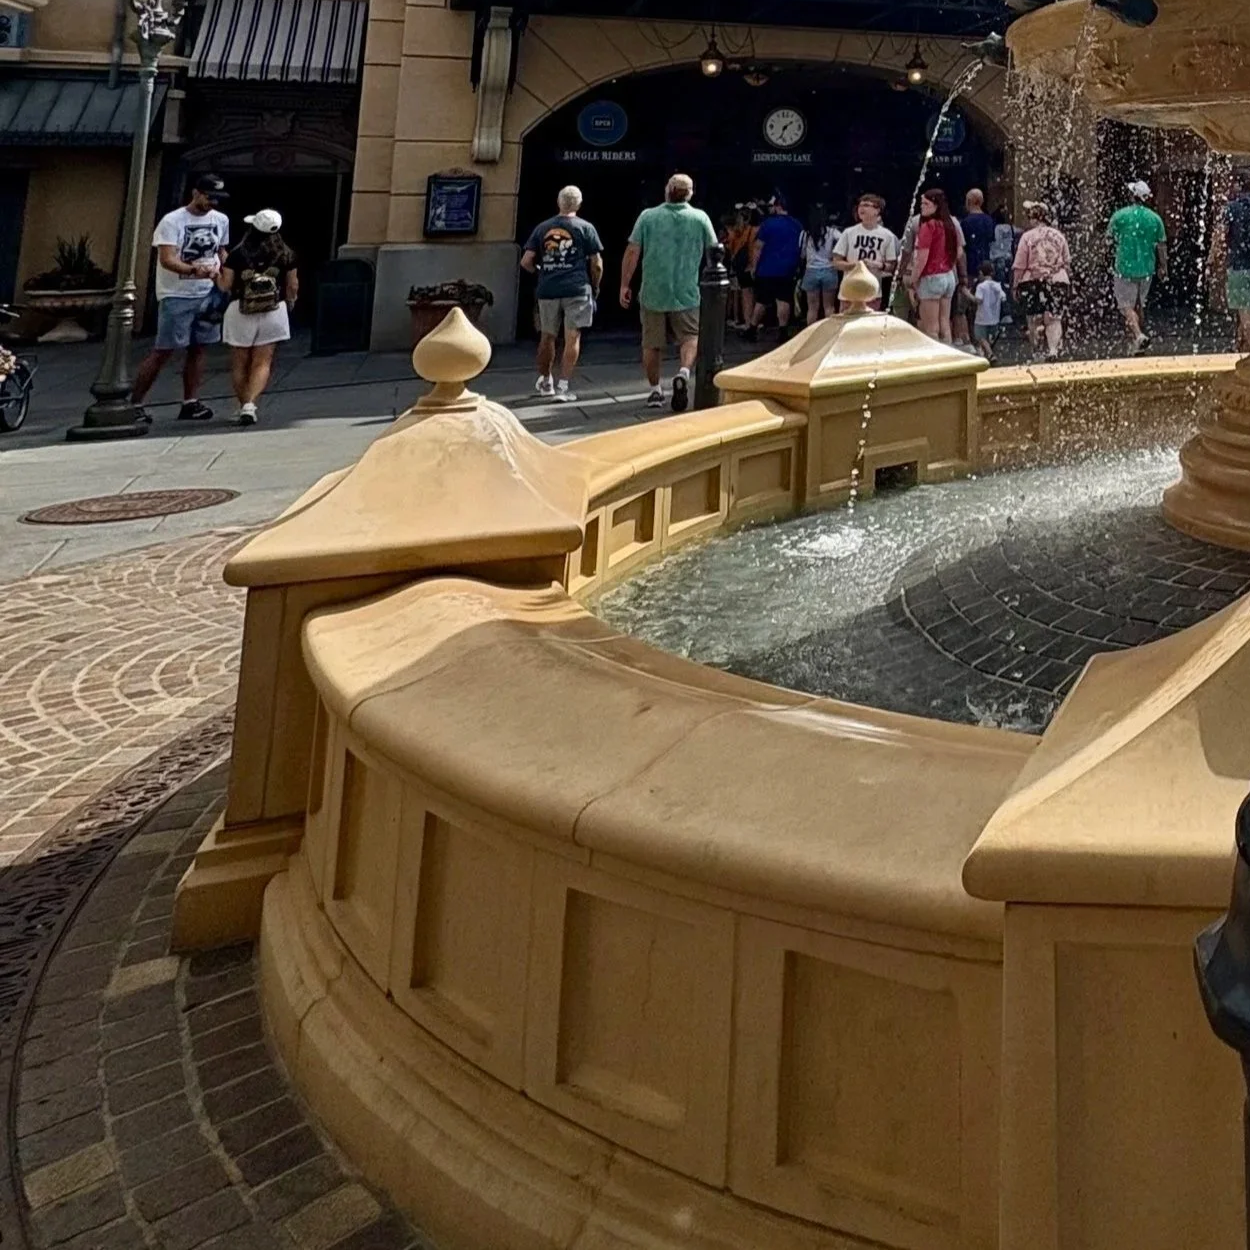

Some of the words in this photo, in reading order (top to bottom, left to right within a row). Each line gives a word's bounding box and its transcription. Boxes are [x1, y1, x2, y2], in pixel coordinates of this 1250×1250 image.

[562, 151, 600, 161] SINGLE
[602, 151, 637, 161] RIDERS
[753, 153, 793, 162] LIGHTNING
[793, 153, 812, 162] LANE
[854, 235, 884, 250] JUST
[858, 248, 877, 261] DO
